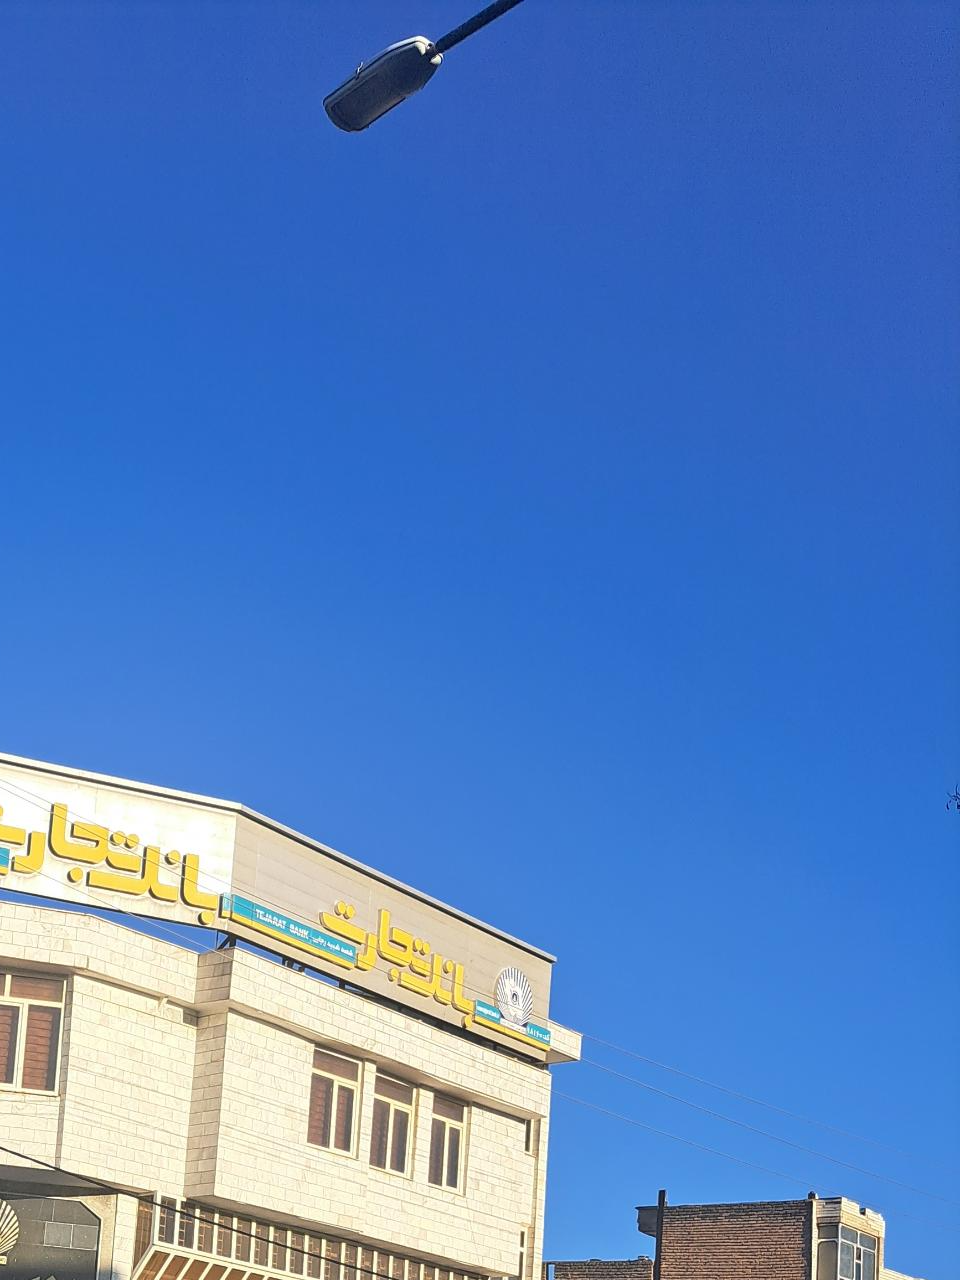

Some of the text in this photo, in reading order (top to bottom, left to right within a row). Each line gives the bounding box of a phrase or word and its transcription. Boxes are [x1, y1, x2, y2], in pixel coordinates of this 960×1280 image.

[85, 845, 219, 926] بانک
[255, 908, 309, 939] TEJARAT BANK
[319, 901, 475, 1029] بانک تجارت
